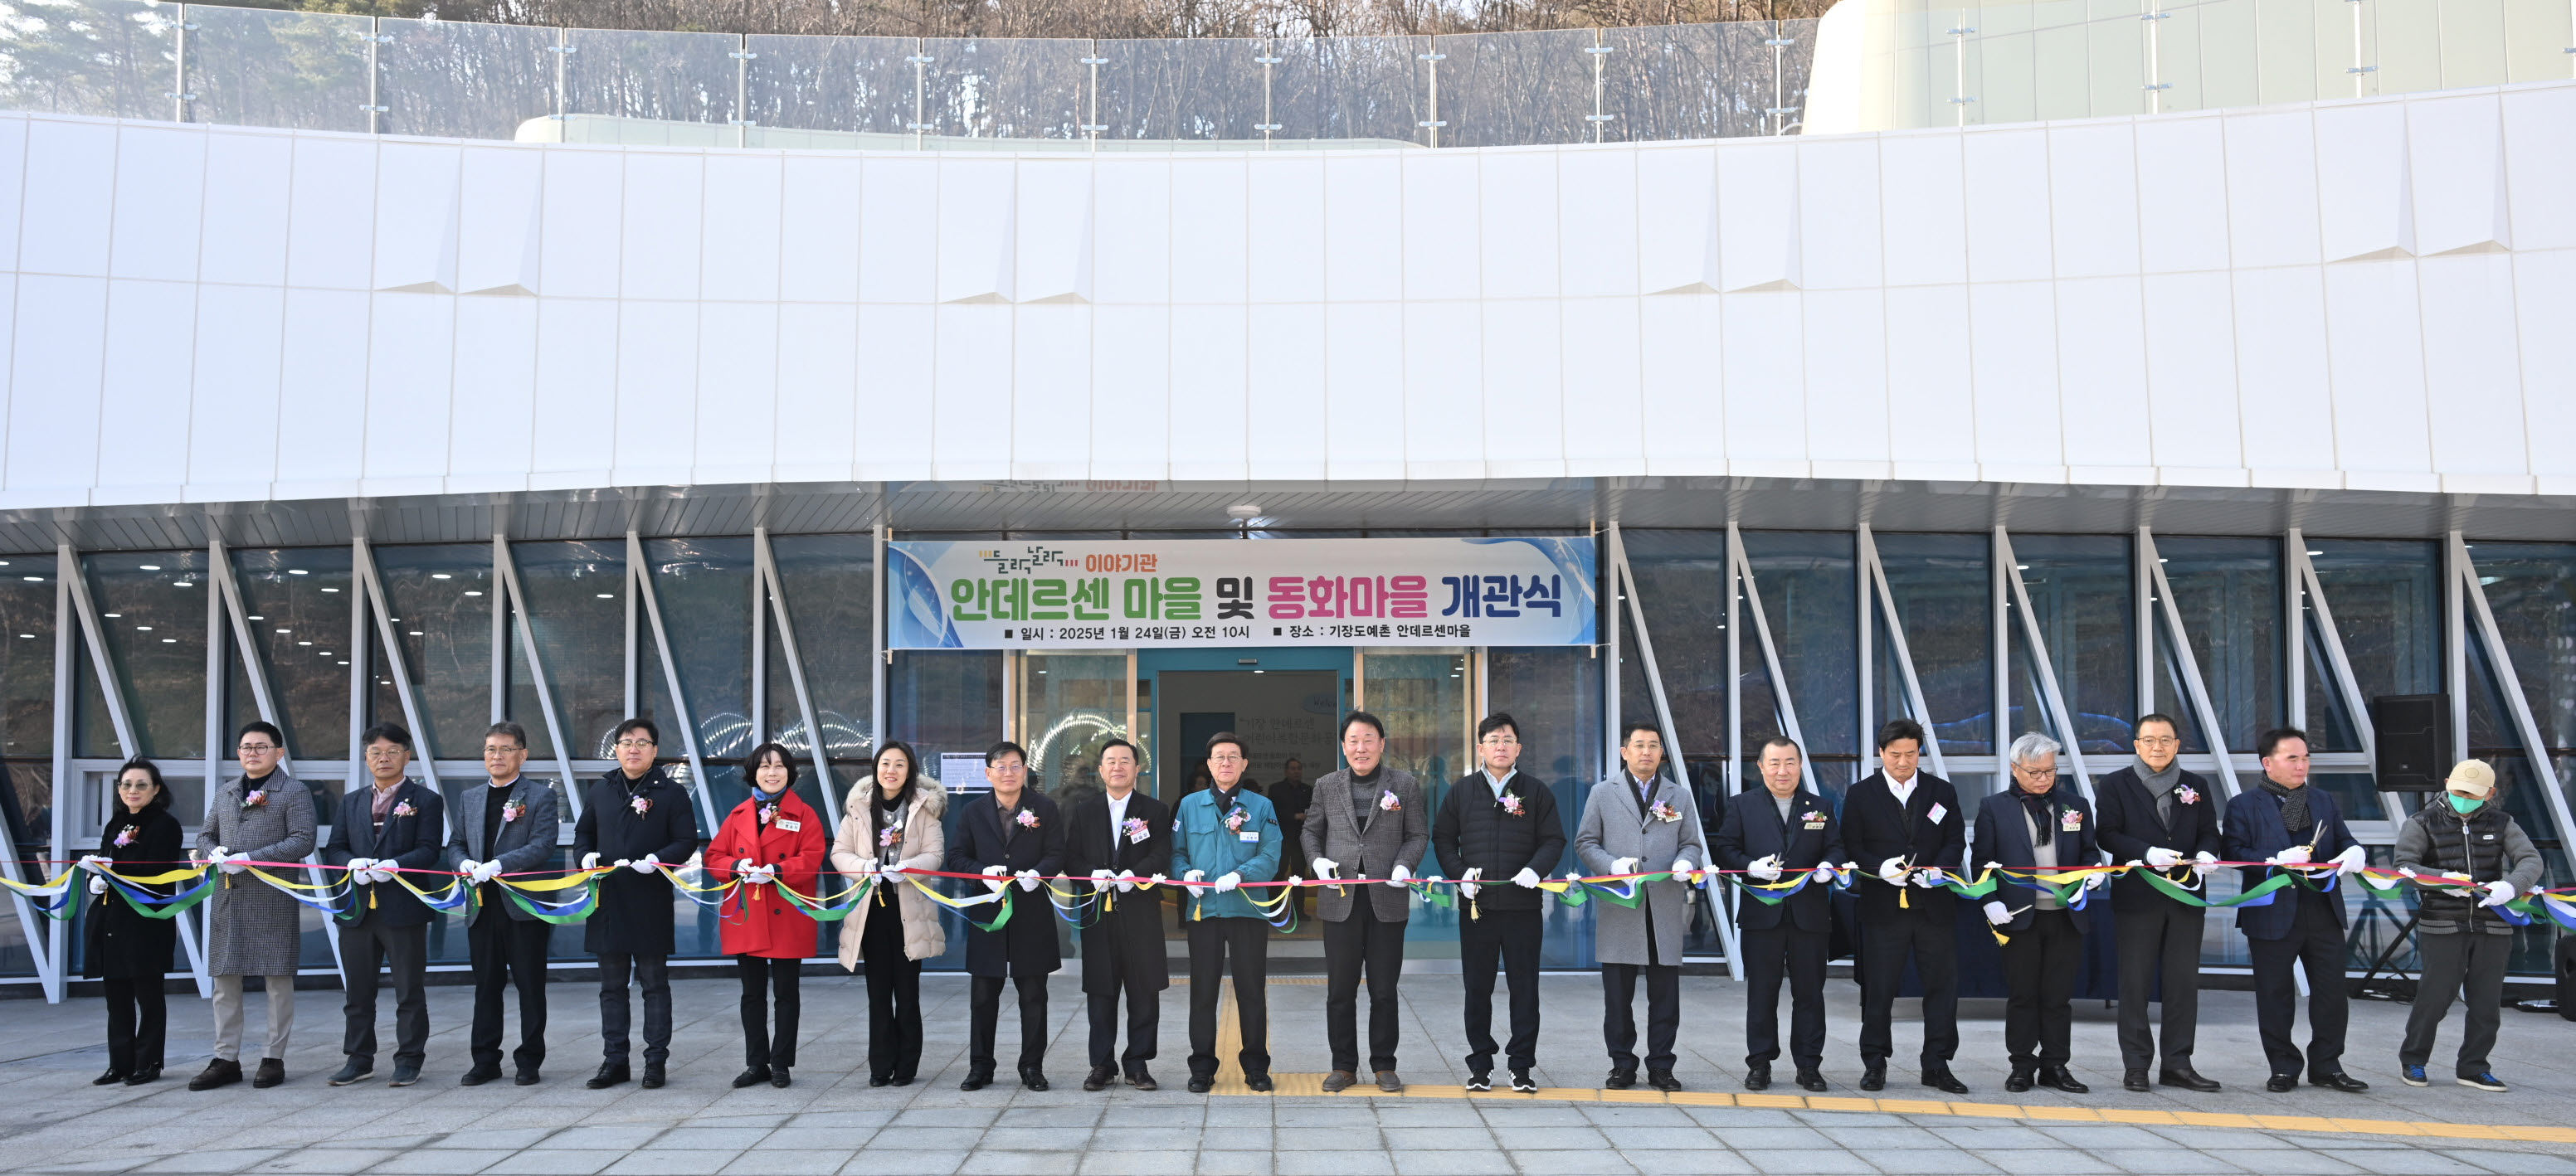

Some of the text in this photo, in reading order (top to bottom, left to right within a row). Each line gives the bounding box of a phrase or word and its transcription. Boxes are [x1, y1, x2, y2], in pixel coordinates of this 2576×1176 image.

[1085, 553, 1158, 573] 이야기관
[951, 574, 1561, 621] 안데르센 마을 및 동화마을 개관식
[1020, 627, 1045, 640] 일시
[1059, 627, 1105, 640] 2025년
[1110, 627, 1129, 640] 1월
[1135, 625, 1186, 640] 24일(금)
[1191, 625, 1215, 639] 오전
[1222, 625, 1250, 639] 10시
[1289, 624, 1314, 638] 장소
[1329, 624, 1391, 638] 기장도예촌
[1396, 624, 1472, 638] 안데르센마을
